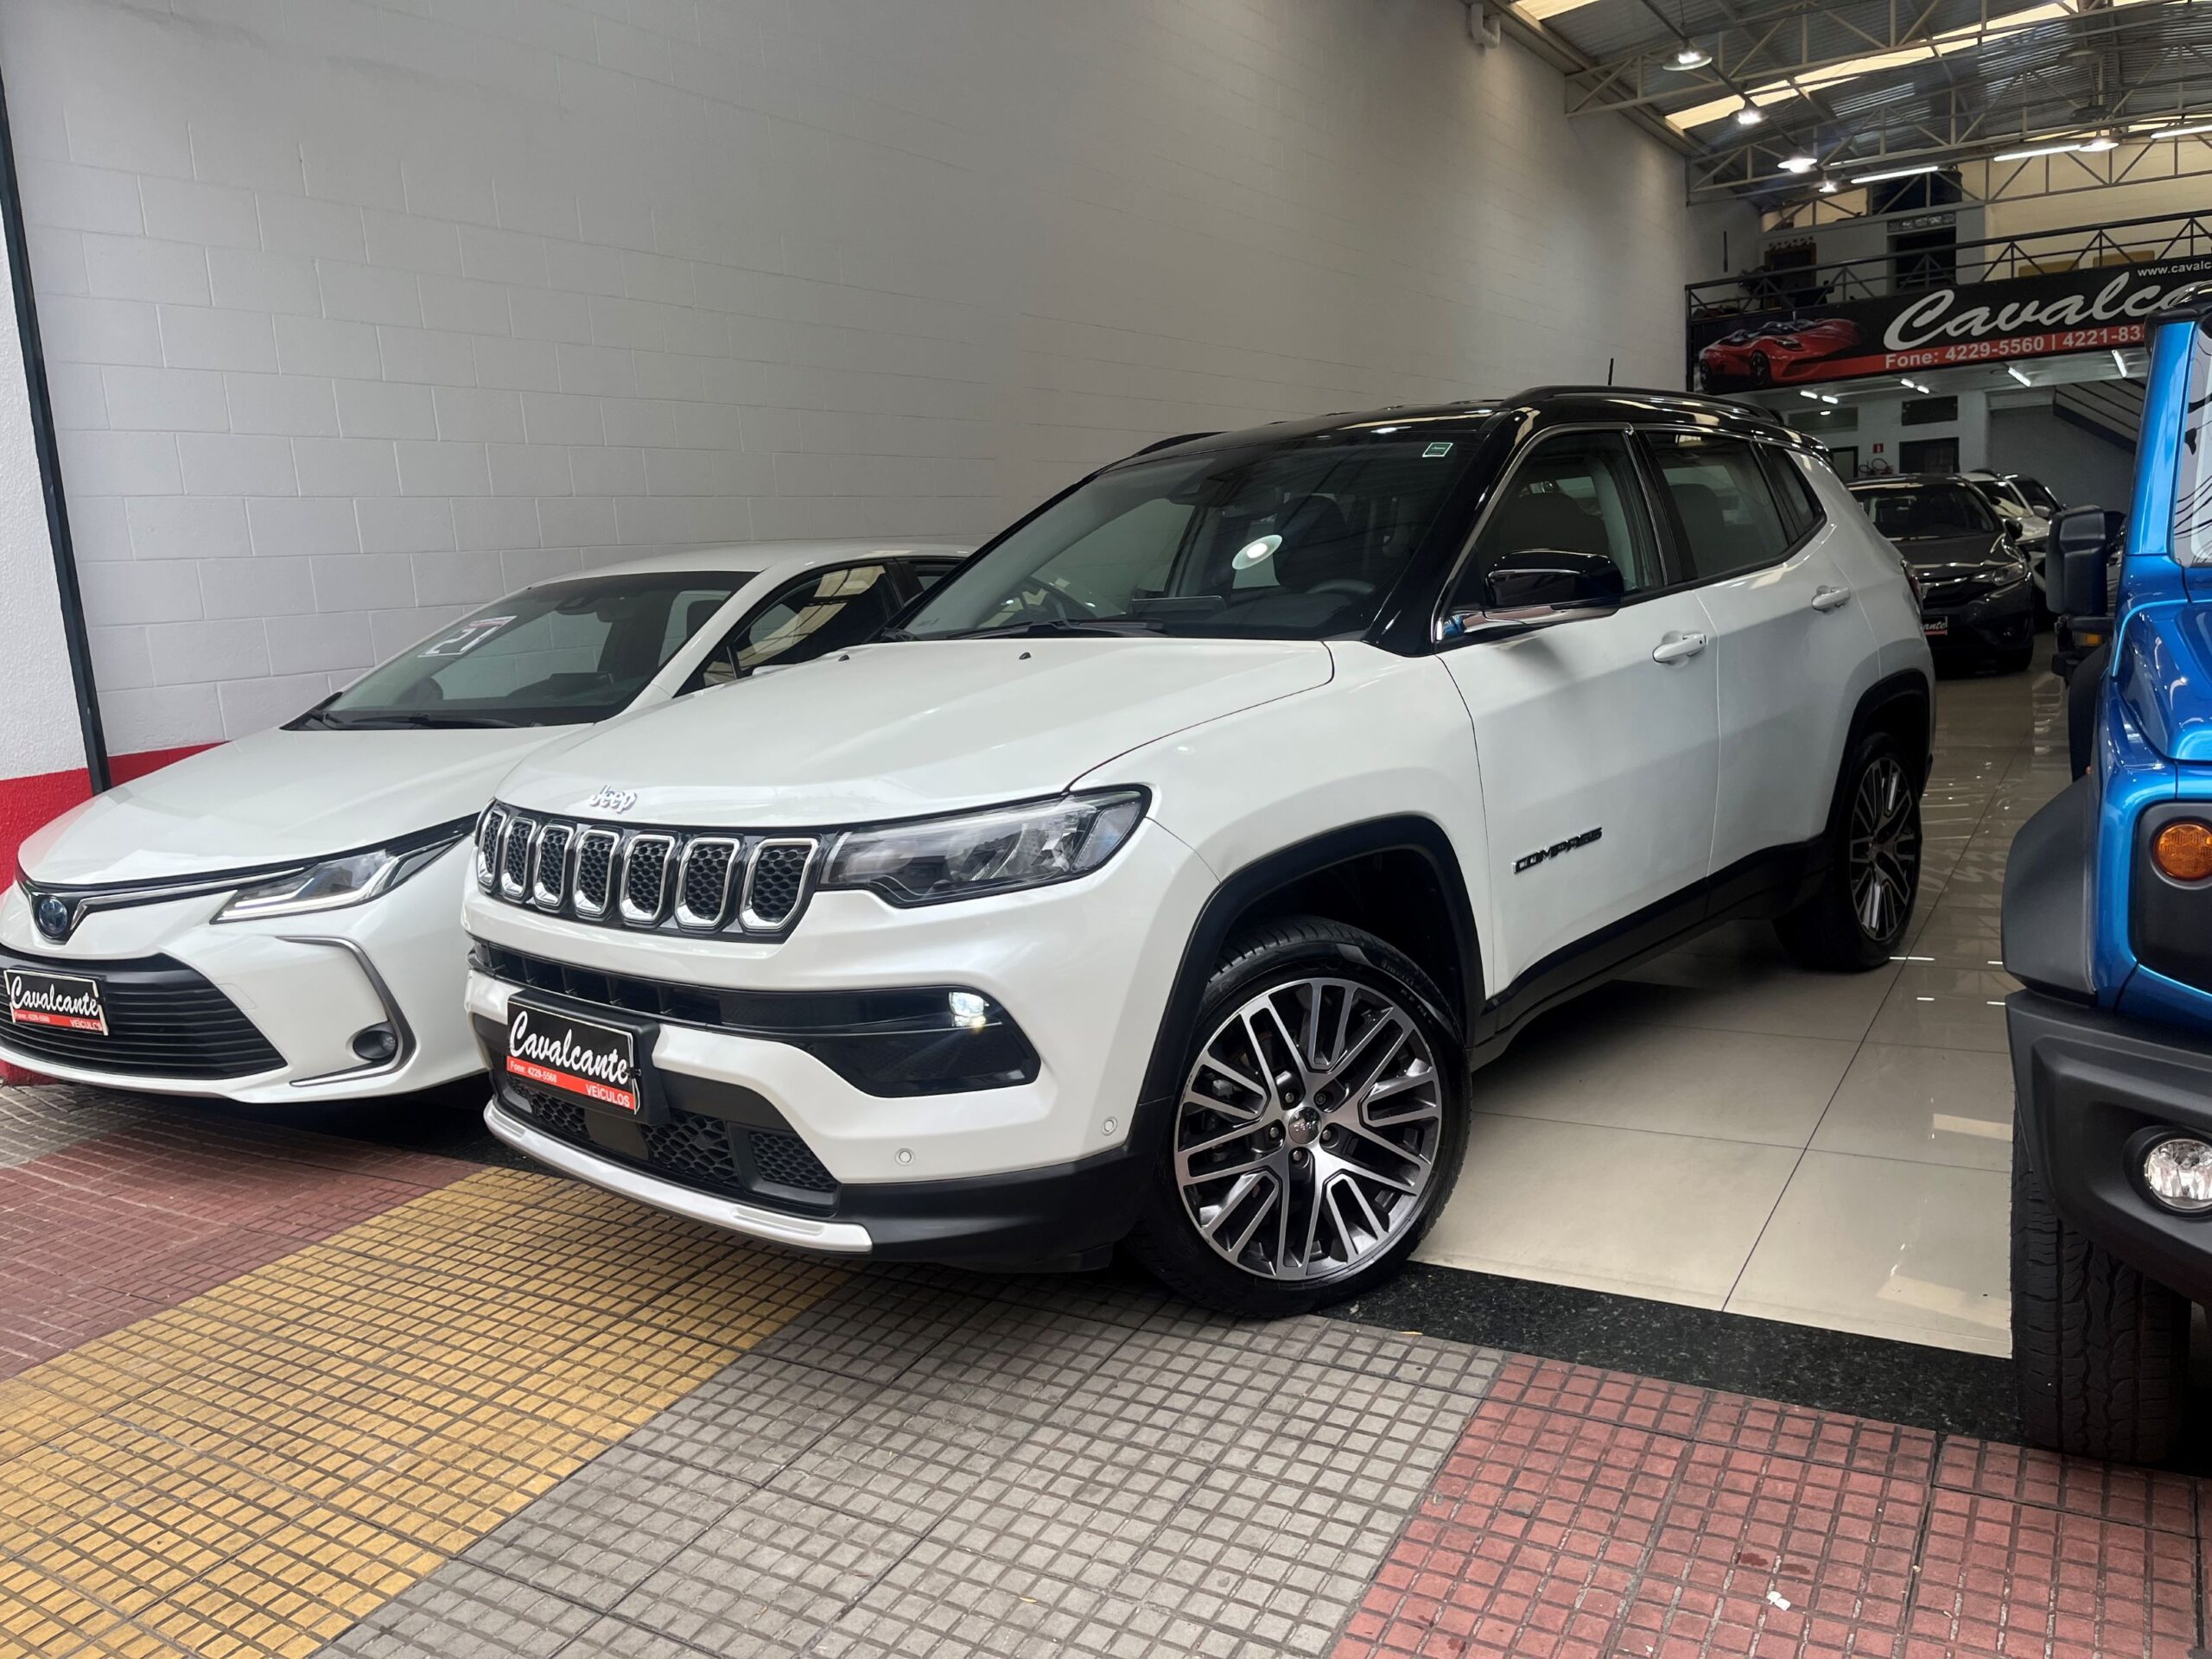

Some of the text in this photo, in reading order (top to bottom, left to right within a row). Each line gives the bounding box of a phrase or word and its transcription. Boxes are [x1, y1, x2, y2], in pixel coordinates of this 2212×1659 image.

[1885, 352, 1939, 369] Fone:
[1945, 335, 2045, 360] 4229-5560
[2063, 324, 2145, 348] 4221-83
[588, 785, 638, 814] Jeep
[1513, 827, 1603, 874] COMPASS
[10, 976, 99, 1017] Cavalcante
[509, 1010, 629, 1085] Cavalcante
